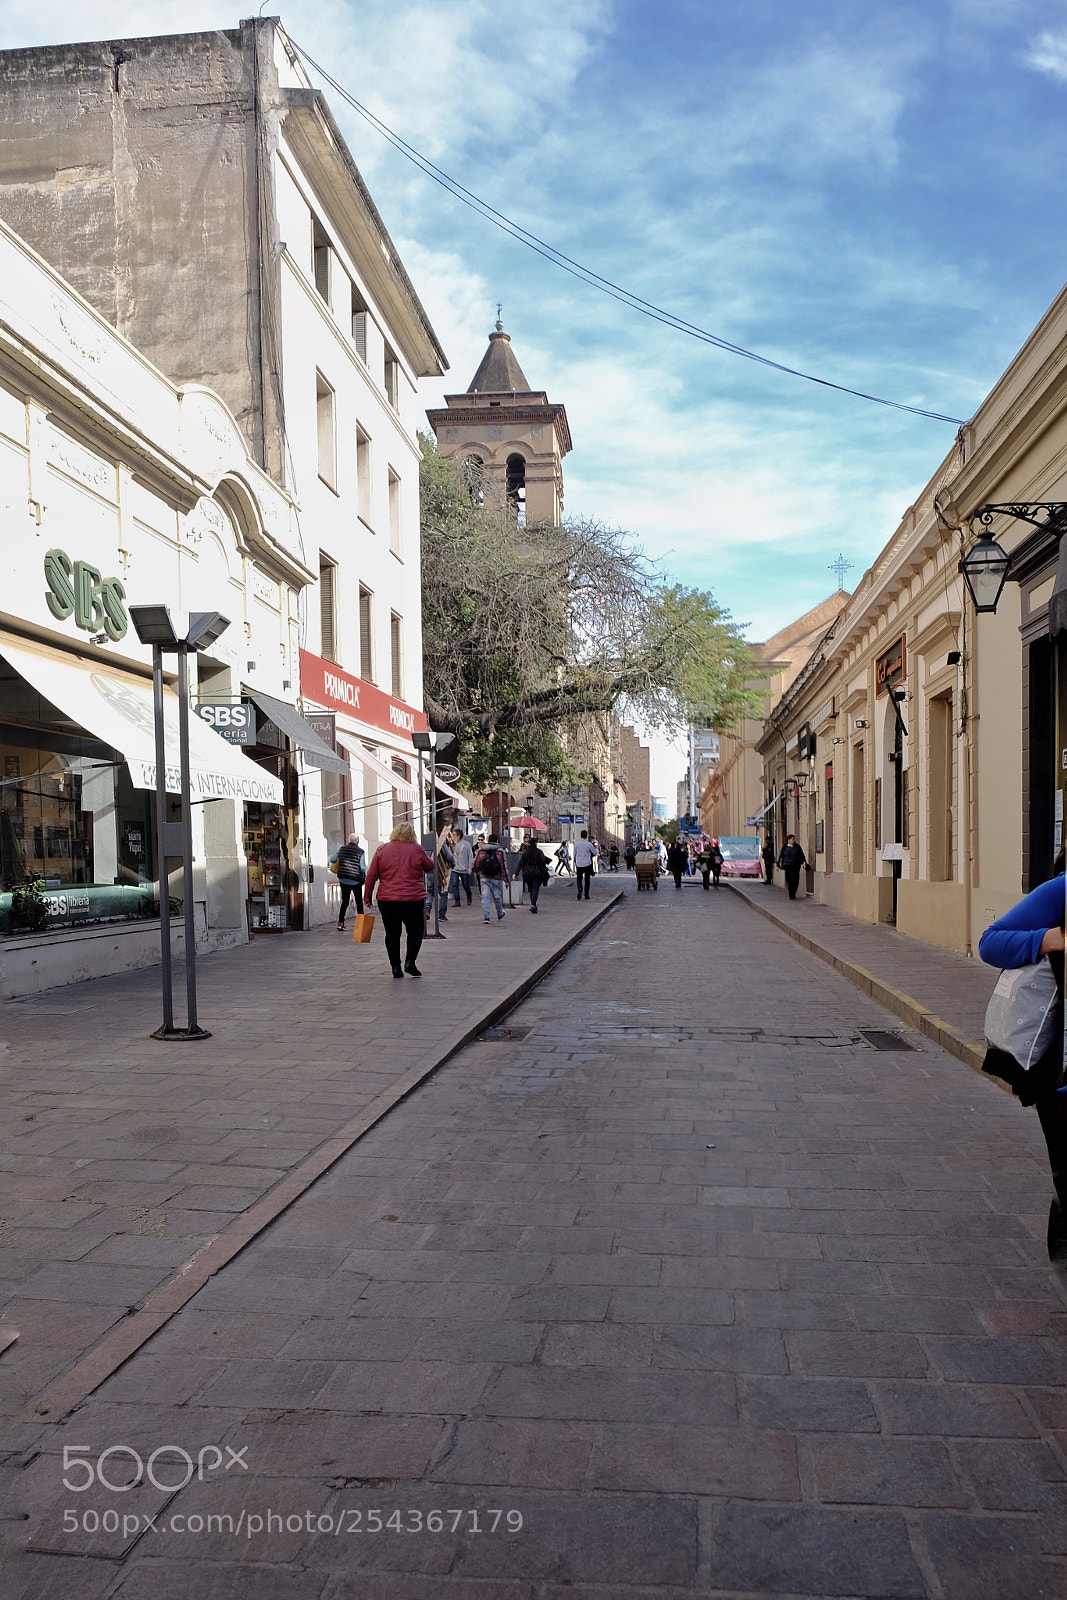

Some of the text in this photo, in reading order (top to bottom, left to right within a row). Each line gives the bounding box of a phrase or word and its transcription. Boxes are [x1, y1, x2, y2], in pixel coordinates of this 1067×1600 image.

[44, 548, 128, 642] SBS
[324, 671, 360, 709] PRIMICIA
[200, 706, 247, 727] SBS
[218, 728, 247, 738] rería
[197, 772, 277, 800] INTERNACIONAL
